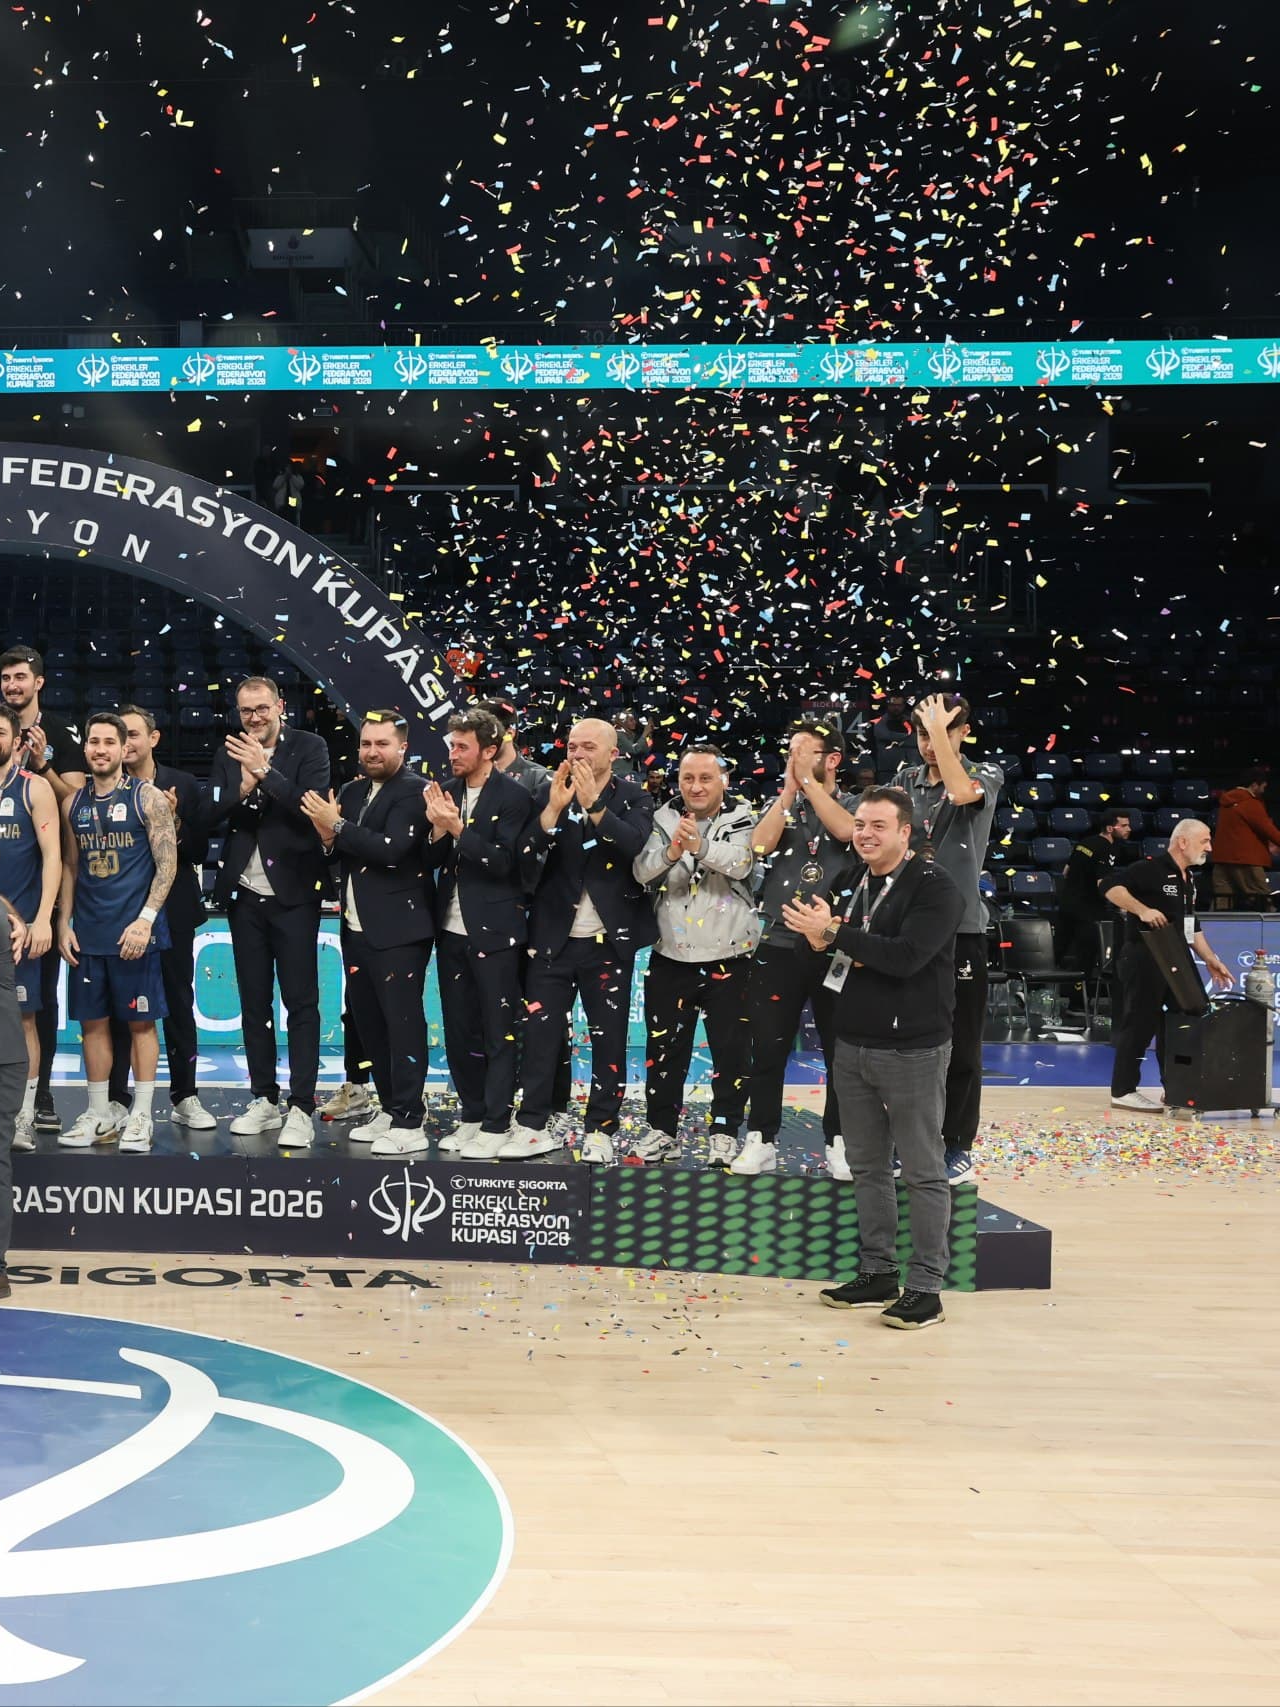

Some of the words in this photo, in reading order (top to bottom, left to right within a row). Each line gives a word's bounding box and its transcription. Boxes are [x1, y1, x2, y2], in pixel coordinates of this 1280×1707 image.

[2, 457, 313, 579] FEDERASYON
[311, 567, 456, 722] KUPASI
[133, 1187, 241, 1216] KUPASI
[250, 1189, 323, 1219] 2026
[452, 1194, 540, 1211] ERKEKLER
[451, 1228, 517, 1244] KUPASI
[524, 1231, 570, 1247] 2026
[8, 1264, 444, 1288] SİGORTA
